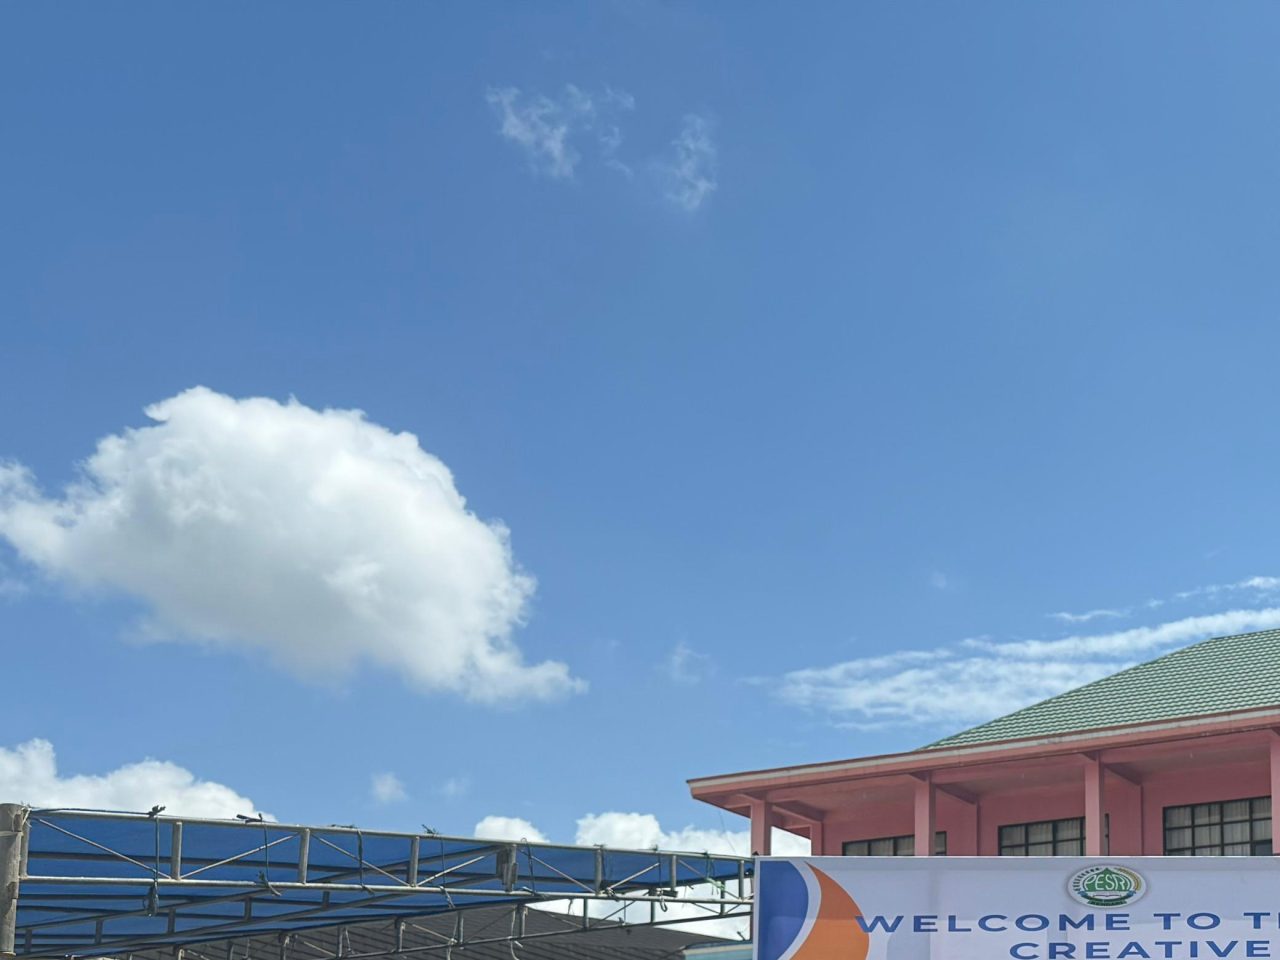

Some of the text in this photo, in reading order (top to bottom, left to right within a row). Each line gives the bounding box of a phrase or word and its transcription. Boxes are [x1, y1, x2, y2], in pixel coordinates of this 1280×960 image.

[855, 912, 1130, 934] WELCOME
[1153, 912, 1221, 931] TO
[1009, 940, 1271, 960] CREATIVE
